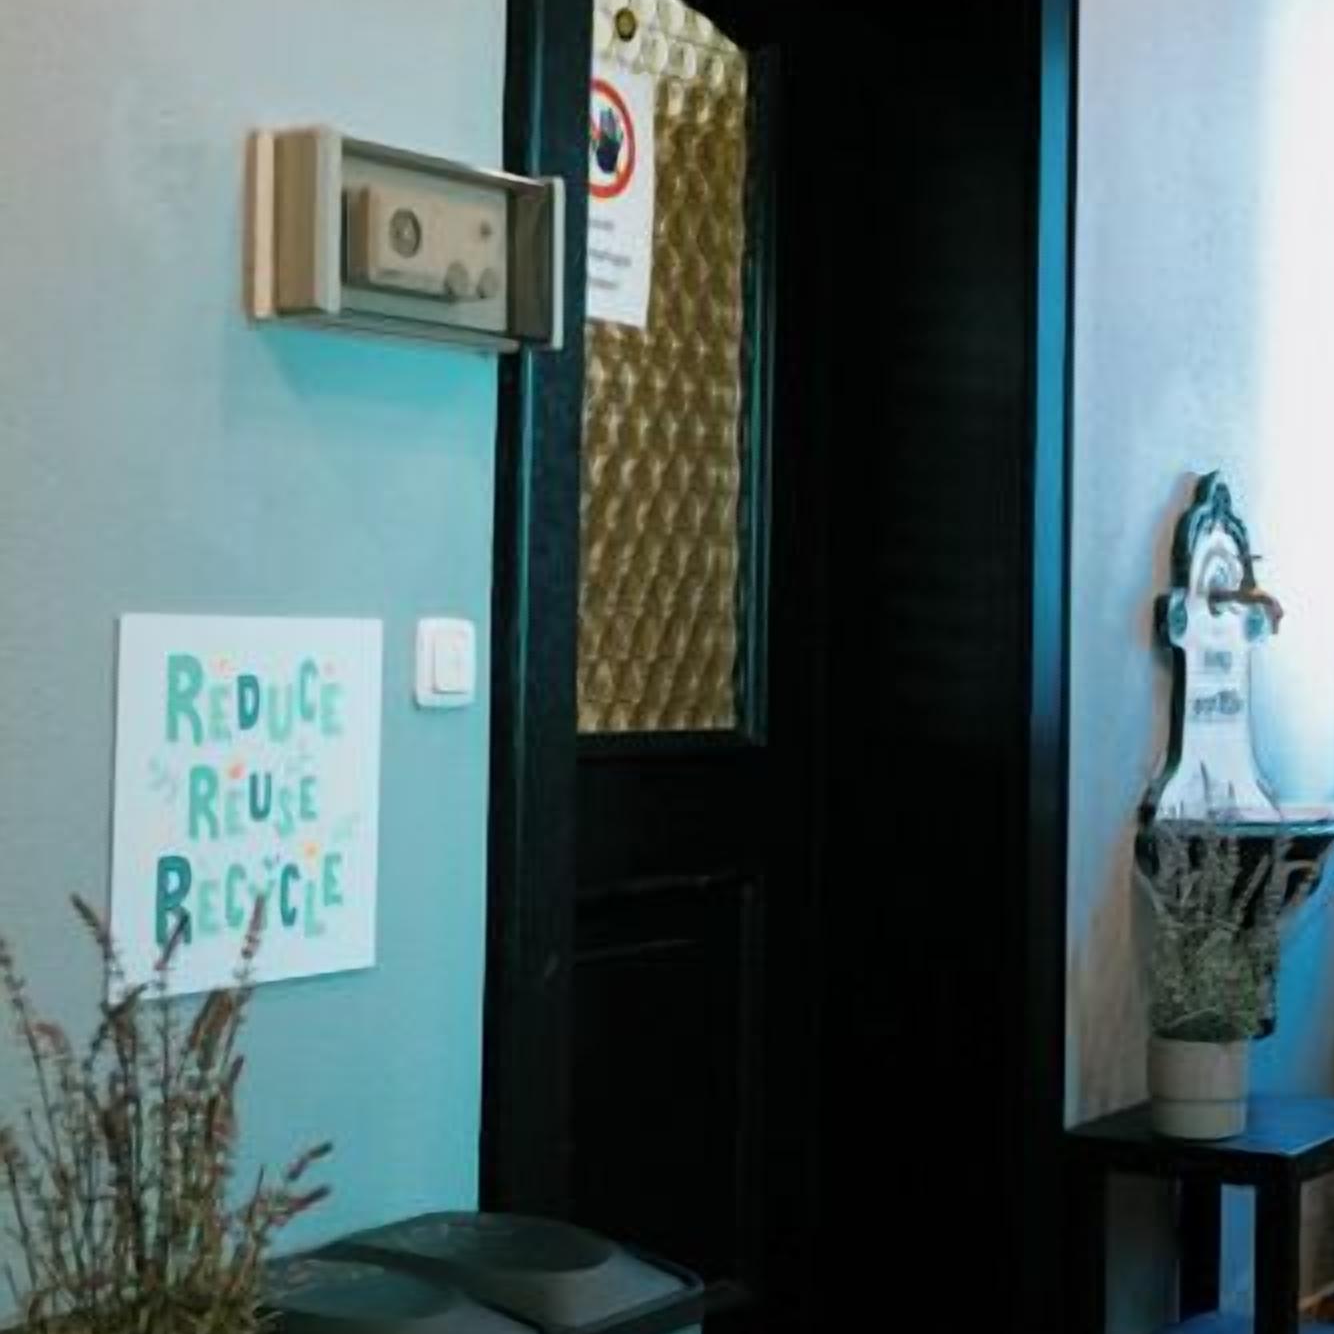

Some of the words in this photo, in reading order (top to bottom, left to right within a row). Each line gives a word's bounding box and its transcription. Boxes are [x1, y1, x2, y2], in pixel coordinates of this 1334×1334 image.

[166, 653, 347, 746] REDUCE
[188, 765, 319, 841] REUSE
[155, 854, 344, 946] RECYCLE
